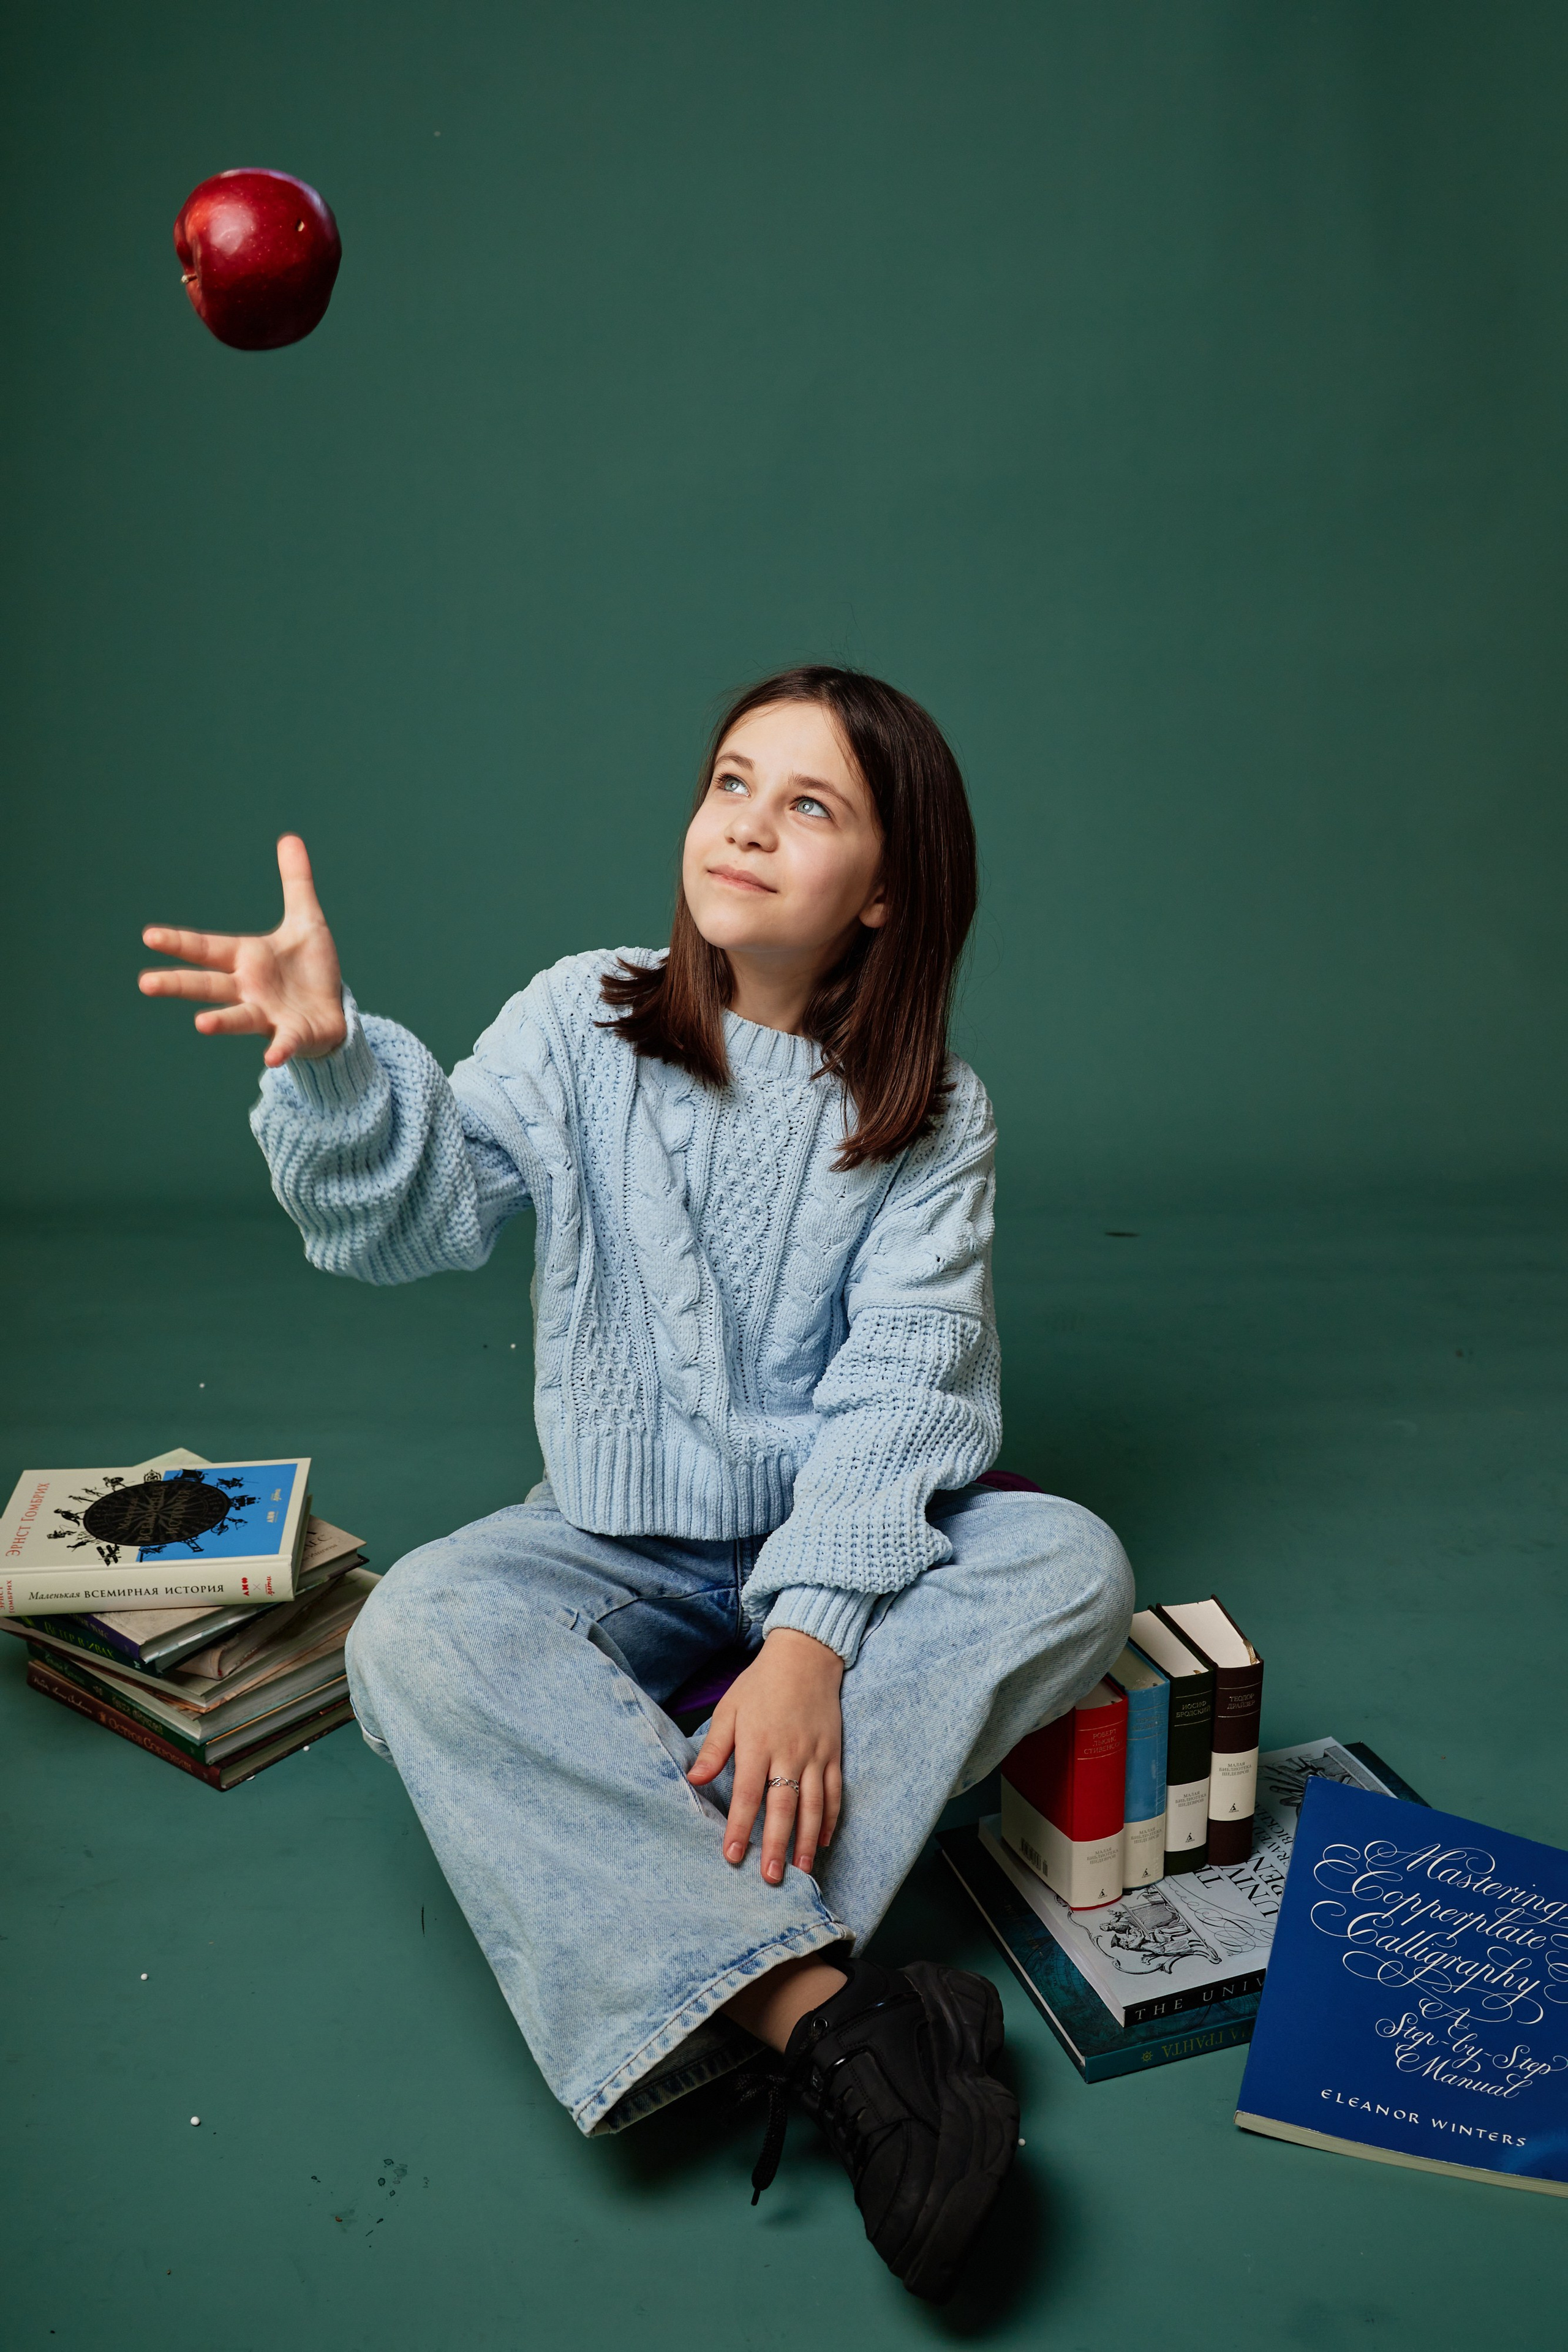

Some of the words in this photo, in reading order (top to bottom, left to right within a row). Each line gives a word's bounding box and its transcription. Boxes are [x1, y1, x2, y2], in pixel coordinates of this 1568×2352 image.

[6, 1526, 31, 1556] ЭРНСТ
[21, 1483, 50, 1521] ГОМБРИХ
[7, 1580, 15, 1613] ГОМБРИХ
[28, 1591, 80, 1600] Маленькая
[85, 1587, 158, 1599] ВСЕМИРНАЯ
[165, 1585, 224, 1595] ИСТОРИЯ
[1229, 1693, 1255, 1702] ТЕОДОР
[1182, 1700, 1207, 1710] ИОСИФ
[1227, 1700, 1256, 1709] ДРАЙЗЕР
[1175, 1705, 1211, 1718] БРОДСКИЙ
[1093, 1728, 1117, 1740] РОБЕРТ
[1092, 1736, 1117, 1746] ЛЬЮИС
[1175, 1793, 1207, 1804] БИБЛИОТЕКА
[1178, 1798, 1204, 1807] ШЕДЕВРОВ
[1131, 1828, 1163, 1840] БИБЛИОТЕКА
[1139, 1826, 1156, 1835] МАЛАЯ
[1134, 1834, 1159, 1844] ШЕДЕВРОВ
[1087, 1849, 1119, 1861] БИБЛИОТЕКА
[1090, 1854, 1116, 1864] ШЕДЕВРОВ
[1245, 1849, 1285, 1898] PEN
[1364, 1840, 1568, 1928] Mastering
[1314, 1844, 1547, 1948] Copperplate
[1135, 1998, 1183, 2020] THE
[1419, 1997, 1470, 2030] A
[1161, 2030, 1224, 2058] ГРАНТА
[1375, 2012, 1568, 2079] Step-by-Step
[1395, 2041, 1532, 2098] Manual
[1321, 2089, 1420, 2124] ELEANOR
[1431, 2117, 1527, 2147] WINTERS
